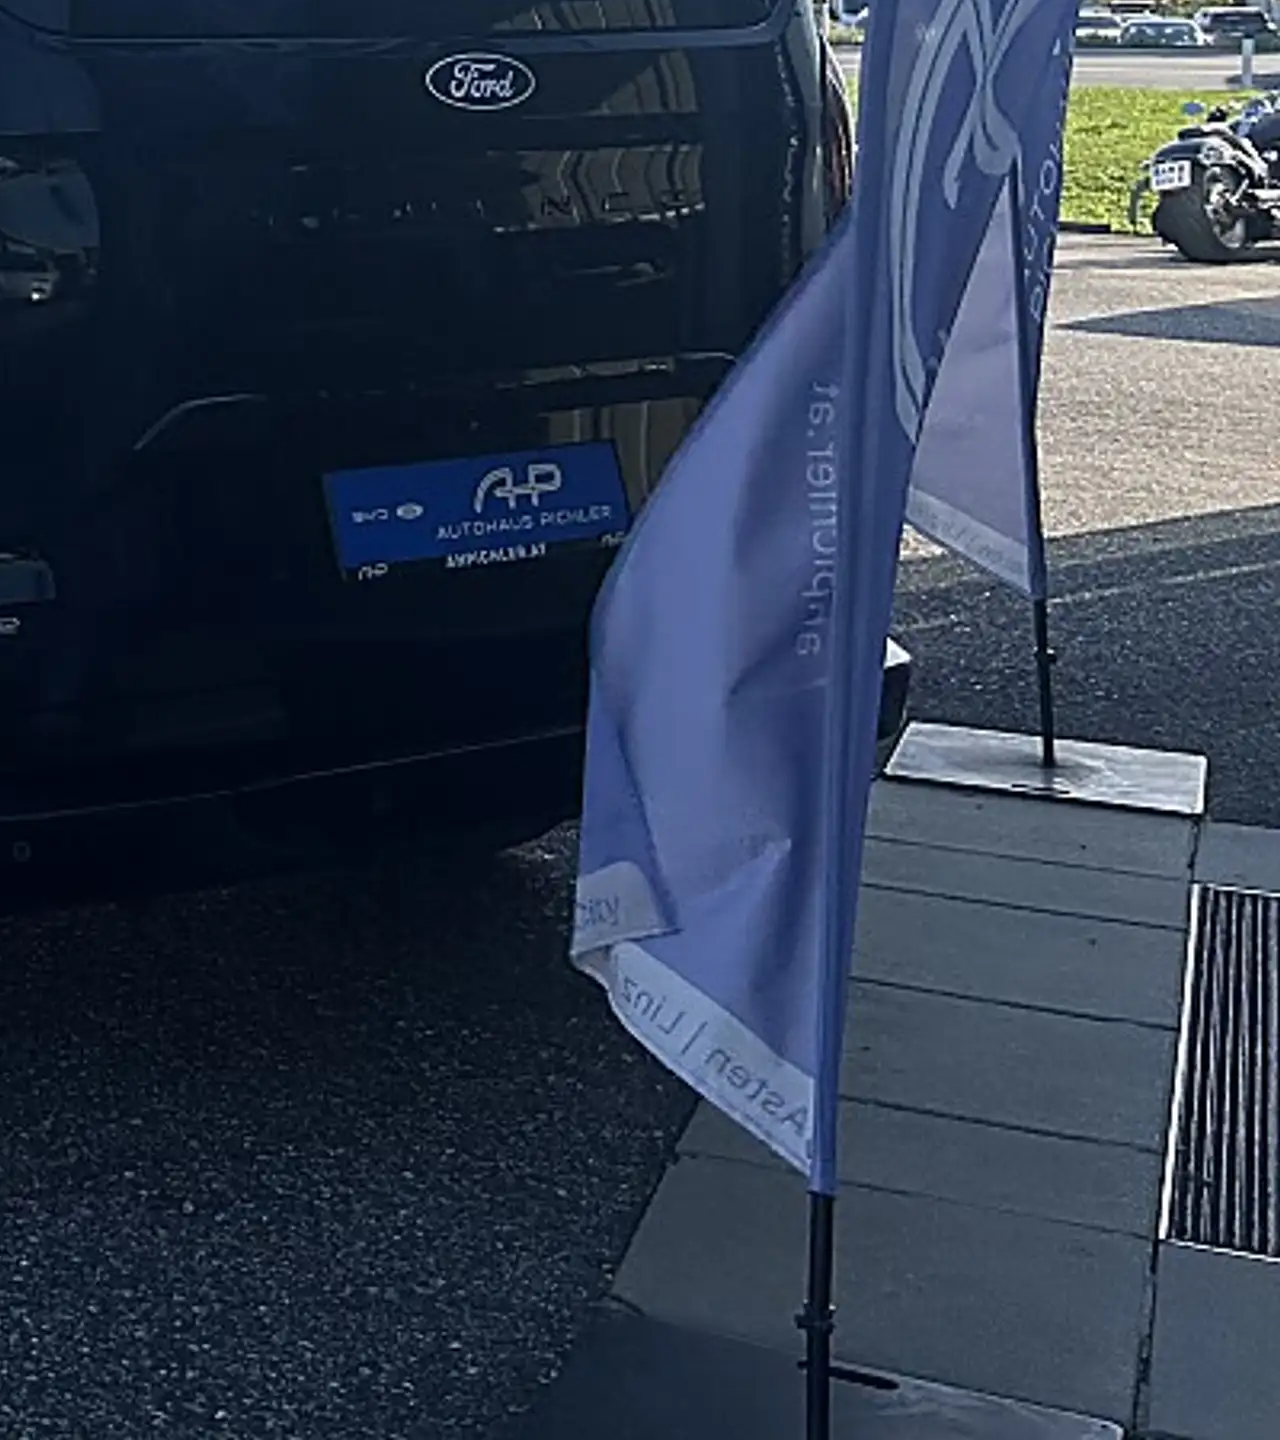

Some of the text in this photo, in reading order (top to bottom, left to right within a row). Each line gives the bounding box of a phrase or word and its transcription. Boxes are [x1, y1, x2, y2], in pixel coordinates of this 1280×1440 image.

[450, 61, 516, 98] Ford
[436, 505, 612, 541] AUTOHAUS PICHLER
